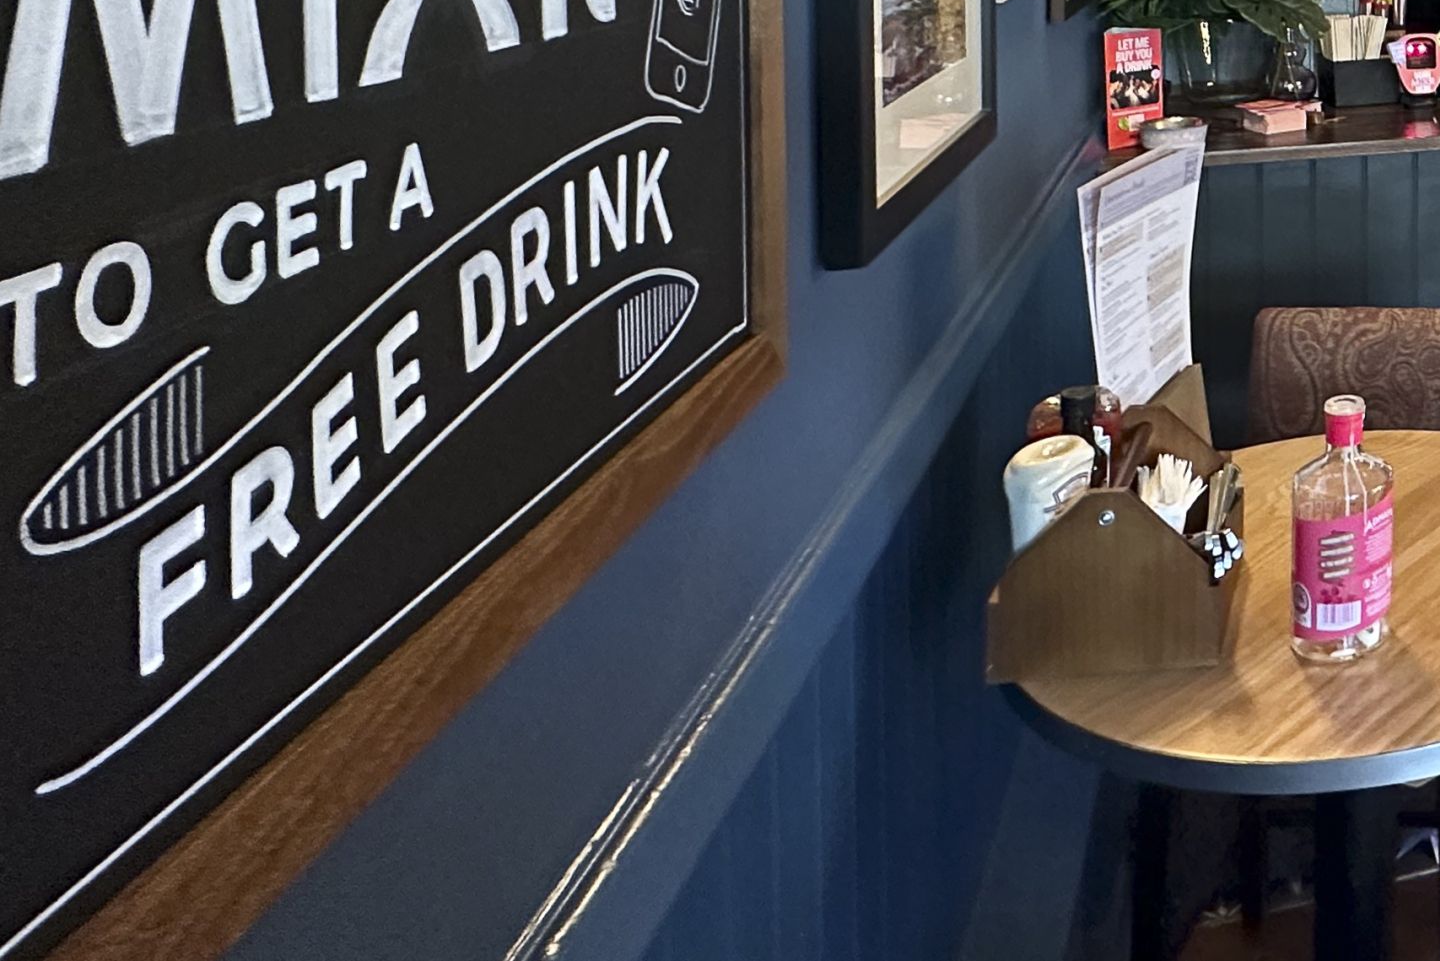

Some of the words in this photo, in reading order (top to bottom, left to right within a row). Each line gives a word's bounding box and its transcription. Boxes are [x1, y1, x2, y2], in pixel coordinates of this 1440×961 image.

[1118, 38, 1134, 51] LET
[1135, 37, 1149, 48] ME
[1115, 50, 1134, 63] BUY
[1135, 47, 1153, 60] YOU
[1116, 62, 1124, 74] A
[1124, 59, 1153, 73] DRINK
[0, 241, 151, 386] TO
[206, 159, 367, 304] GET
[388, 142, 434, 231] A
[138, 309, 427, 676] FREE
[458, 147, 673, 373] DRINK
